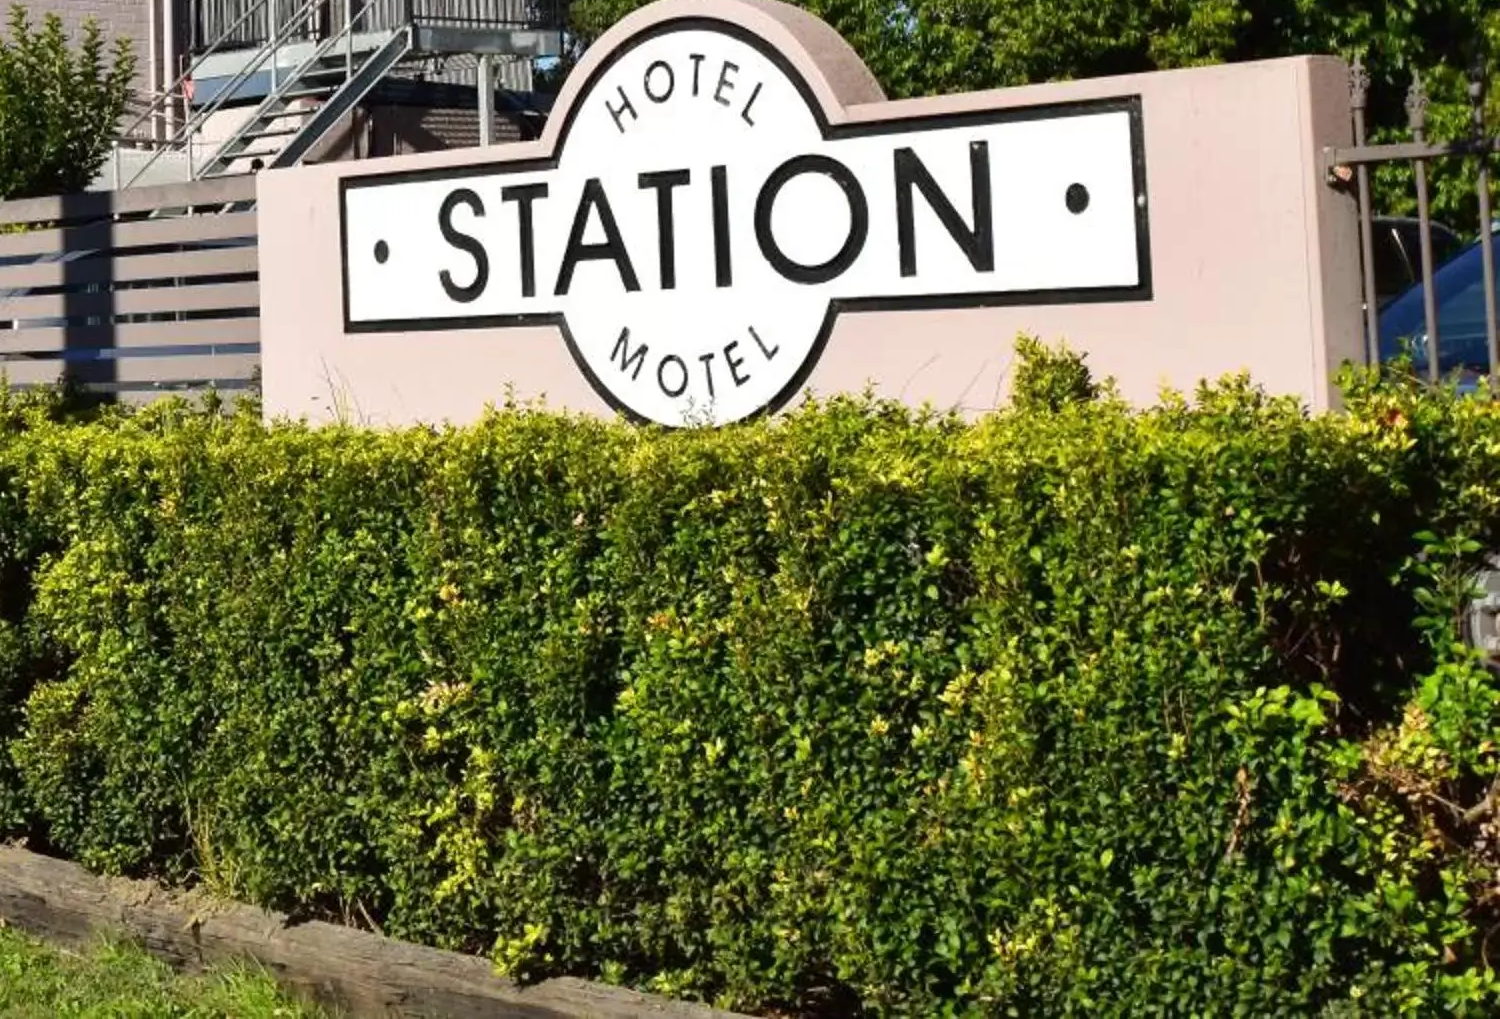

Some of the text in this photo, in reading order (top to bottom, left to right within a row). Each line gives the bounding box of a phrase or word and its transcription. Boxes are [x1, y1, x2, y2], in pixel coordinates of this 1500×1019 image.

[606, 53, 762, 132] HOTEL
[439, 140, 995, 303] STATION
[610, 326, 780, 398] MOTEL
